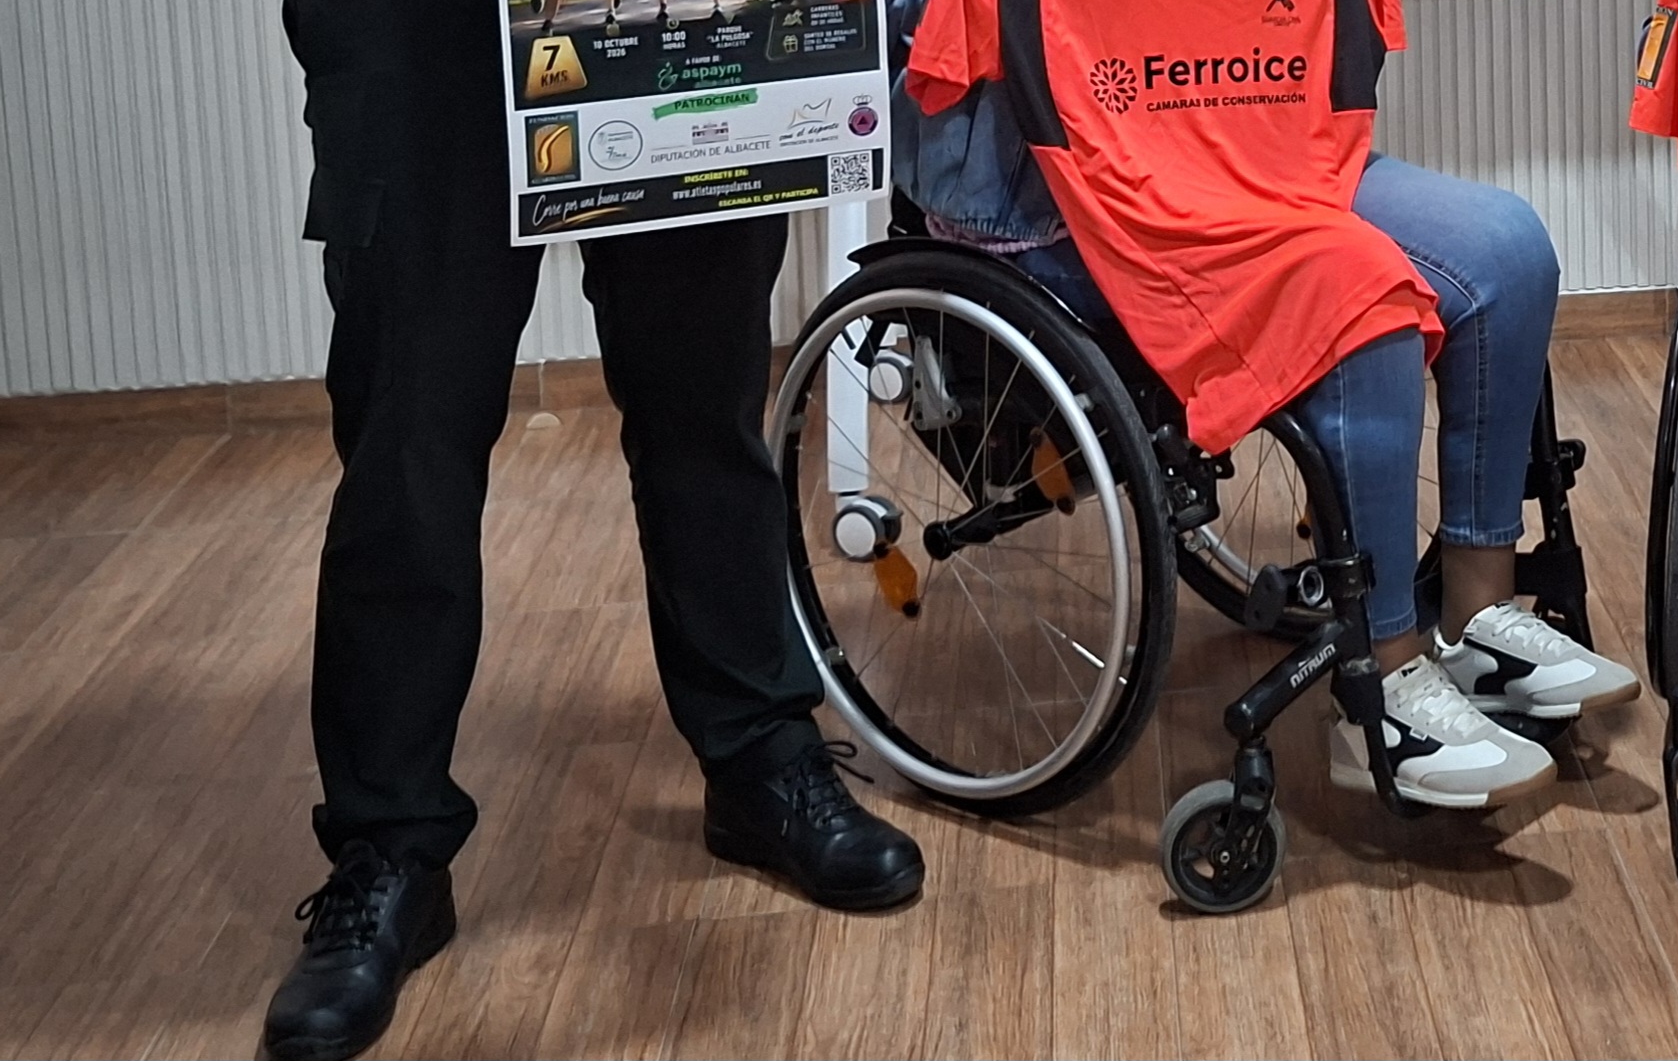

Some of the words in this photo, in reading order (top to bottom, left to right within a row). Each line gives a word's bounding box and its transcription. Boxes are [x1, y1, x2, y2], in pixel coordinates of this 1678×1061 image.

[604, 36, 639, 49] OCTUBRE
[661, 31, 687, 42] 10:00
[542, 44, 561, 71] 7
[682, 62, 742, 80] aspaym
[1143, 47, 1308, 90] Ferroice
[674, 93, 750, 111] PATROCINAN
[1203, 96, 1219, 108] DE
[1221, 92, 1307, 107] CONSERVACIÓN
[709, 146, 721, 157] DE
[723, 140, 771, 155] ALBACETE
[1289, 642, 1337, 689] NITRUM
